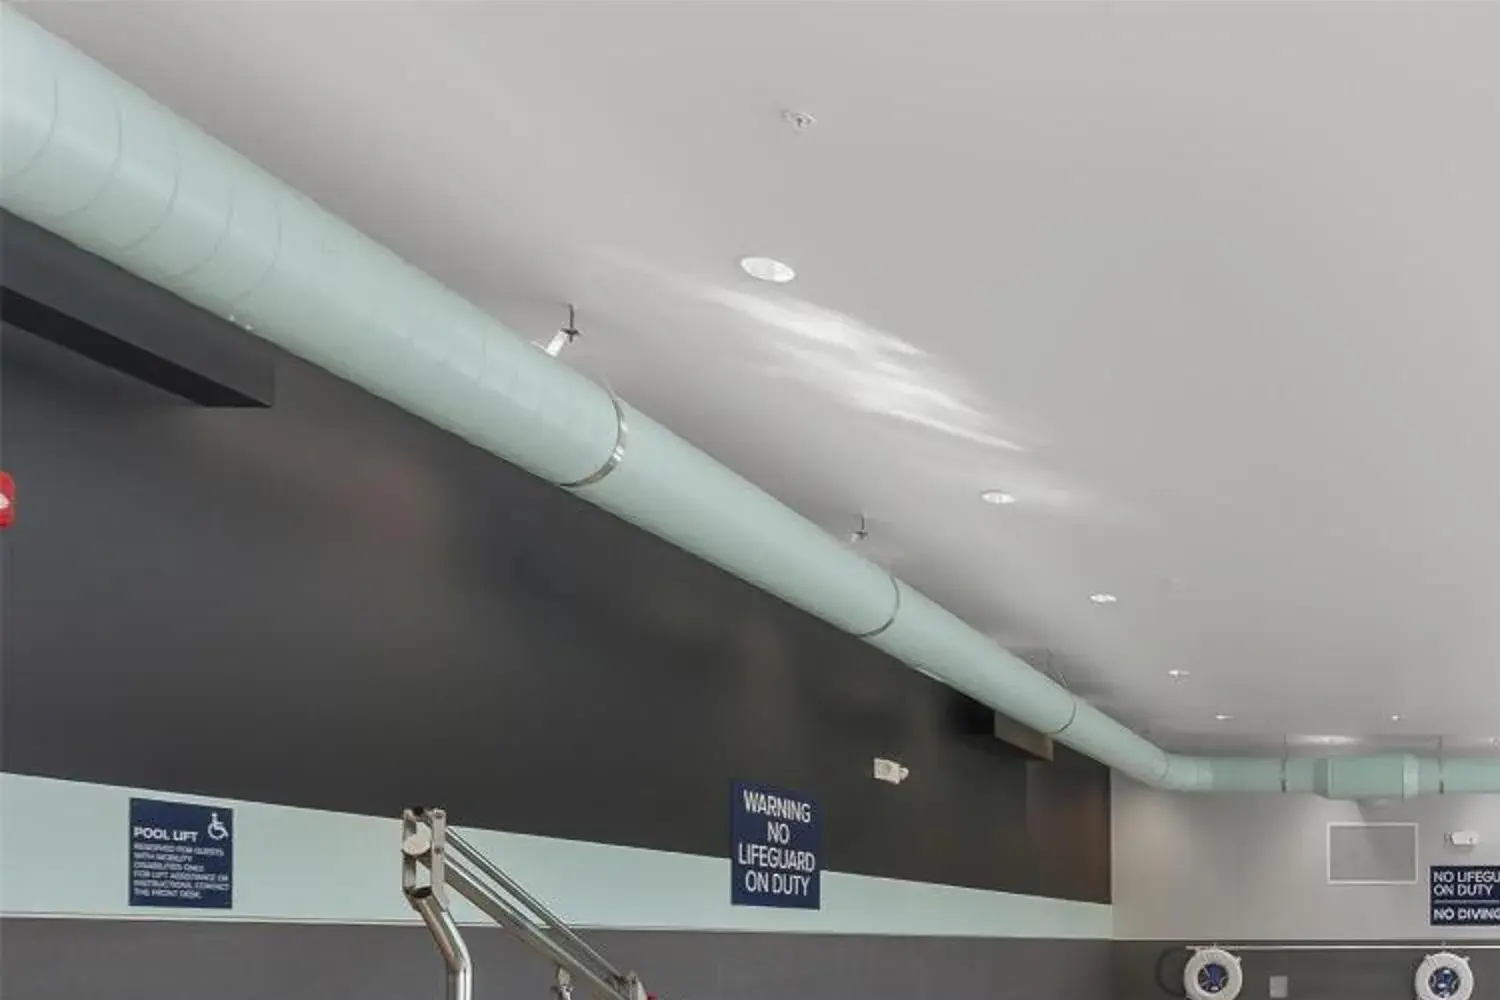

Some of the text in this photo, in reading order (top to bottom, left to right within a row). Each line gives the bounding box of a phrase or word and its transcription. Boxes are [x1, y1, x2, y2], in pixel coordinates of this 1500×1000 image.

[743, 789, 811, 823] WARNING
[133, 827, 198, 842] POOL LIFT
[767, 821, 790, 845] NO
[738, 842, 816, 872] LIFEGUARD
[745, 870, 811, 896] ON DUTY
[1433, 871, 1455, 883] NO
[1433, 884, 1494, 896] ON DUTY
[1433, 907, 1455, 920] NO
